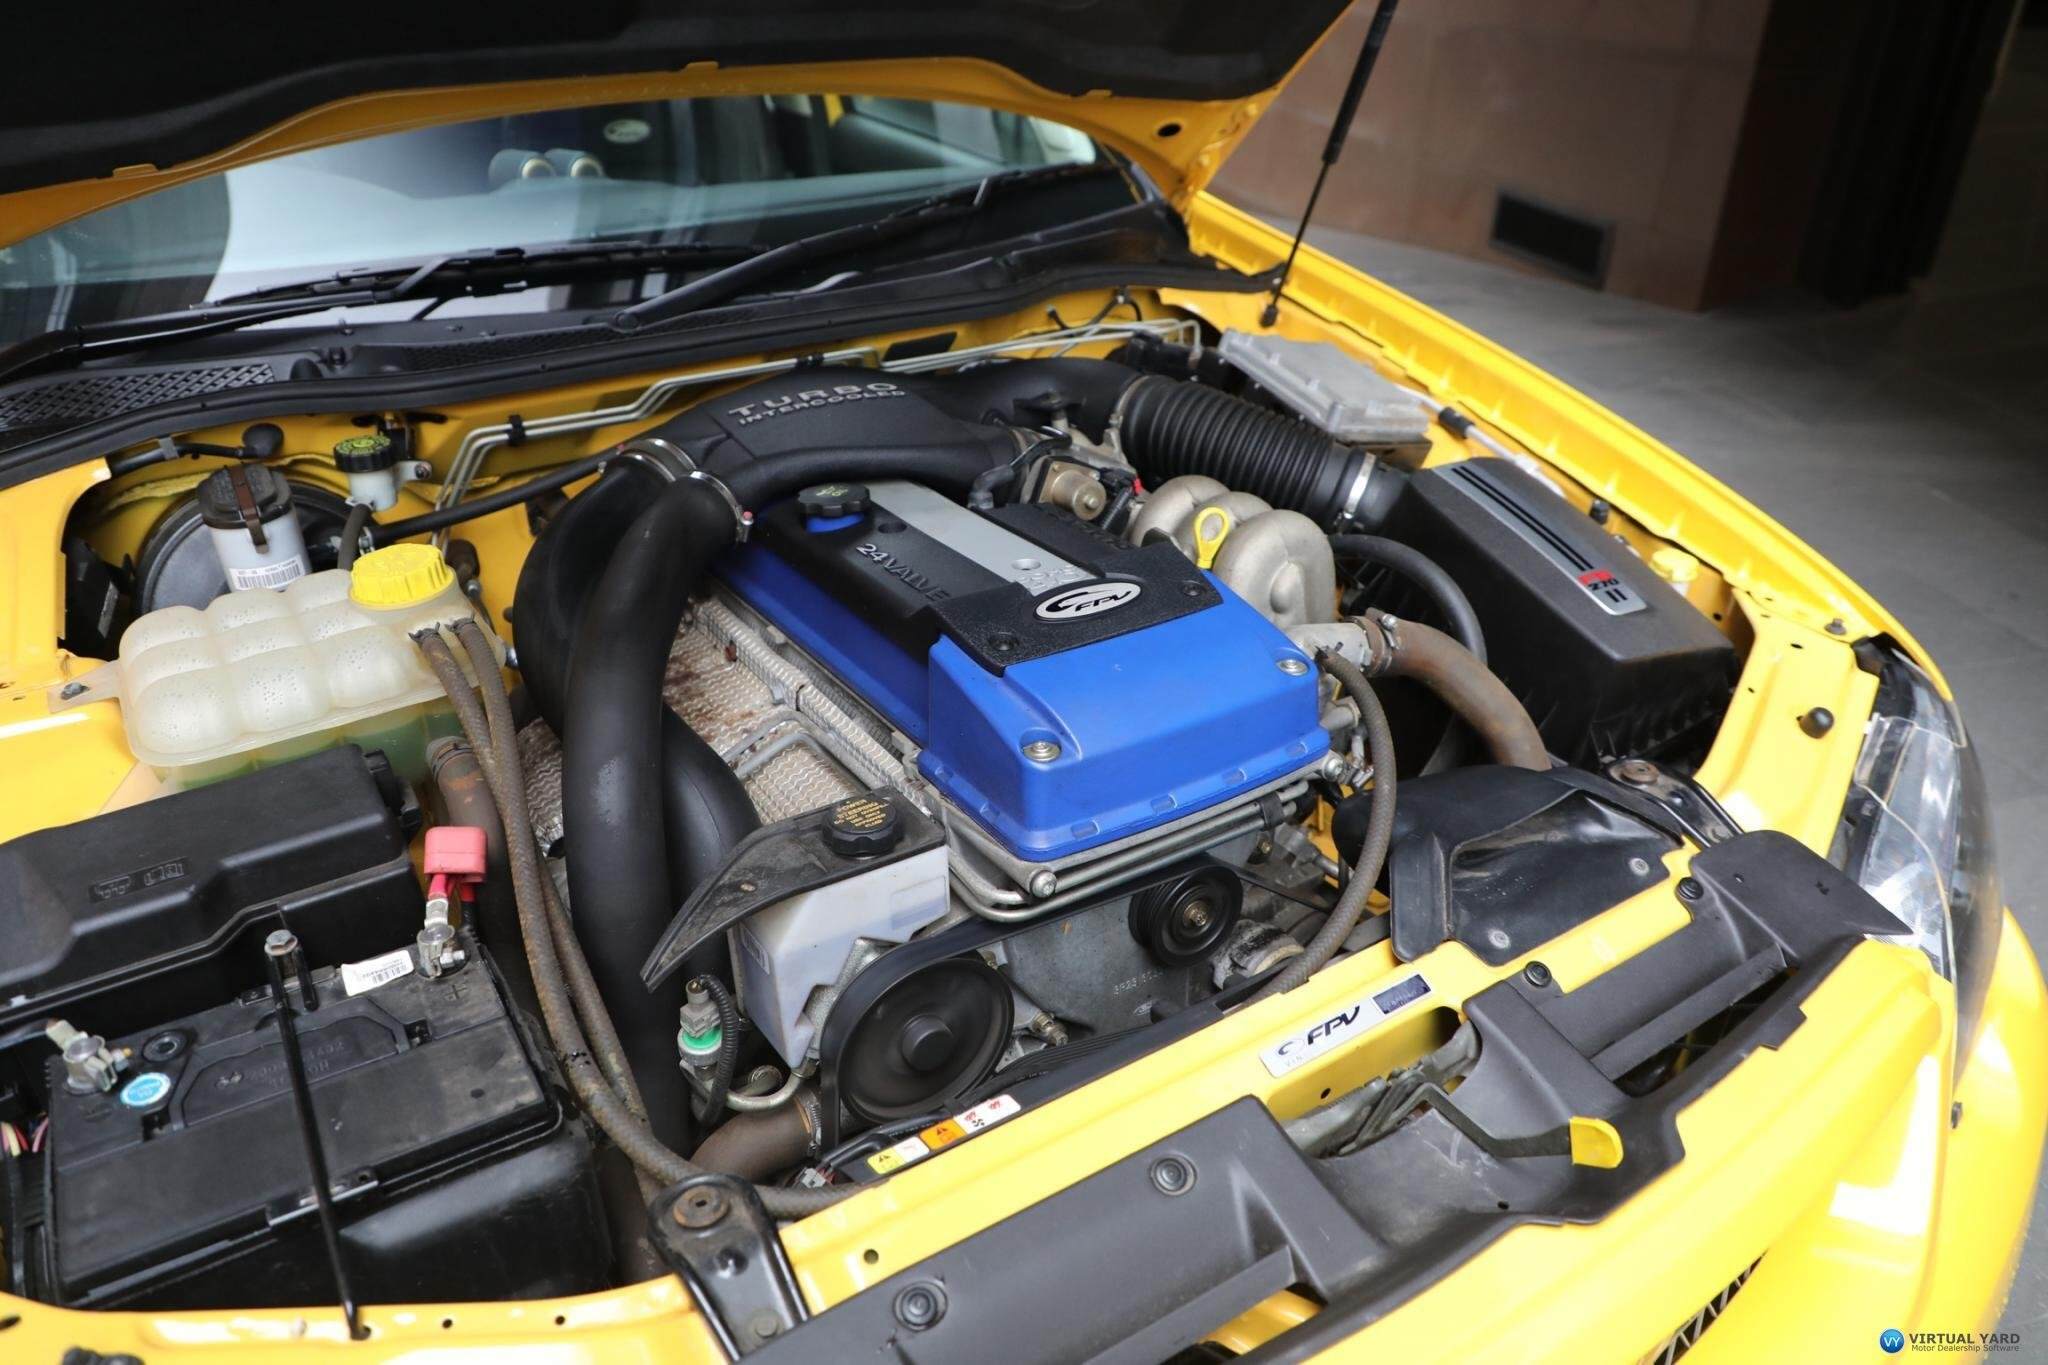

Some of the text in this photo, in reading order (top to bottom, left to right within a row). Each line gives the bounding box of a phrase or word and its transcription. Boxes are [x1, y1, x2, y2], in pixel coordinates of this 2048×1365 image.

[728, 382, 898, 417] TURBO
[738, 390, 906, 425] INTERCOOLED
[1307, 1005, 1360, 1045] FPV
